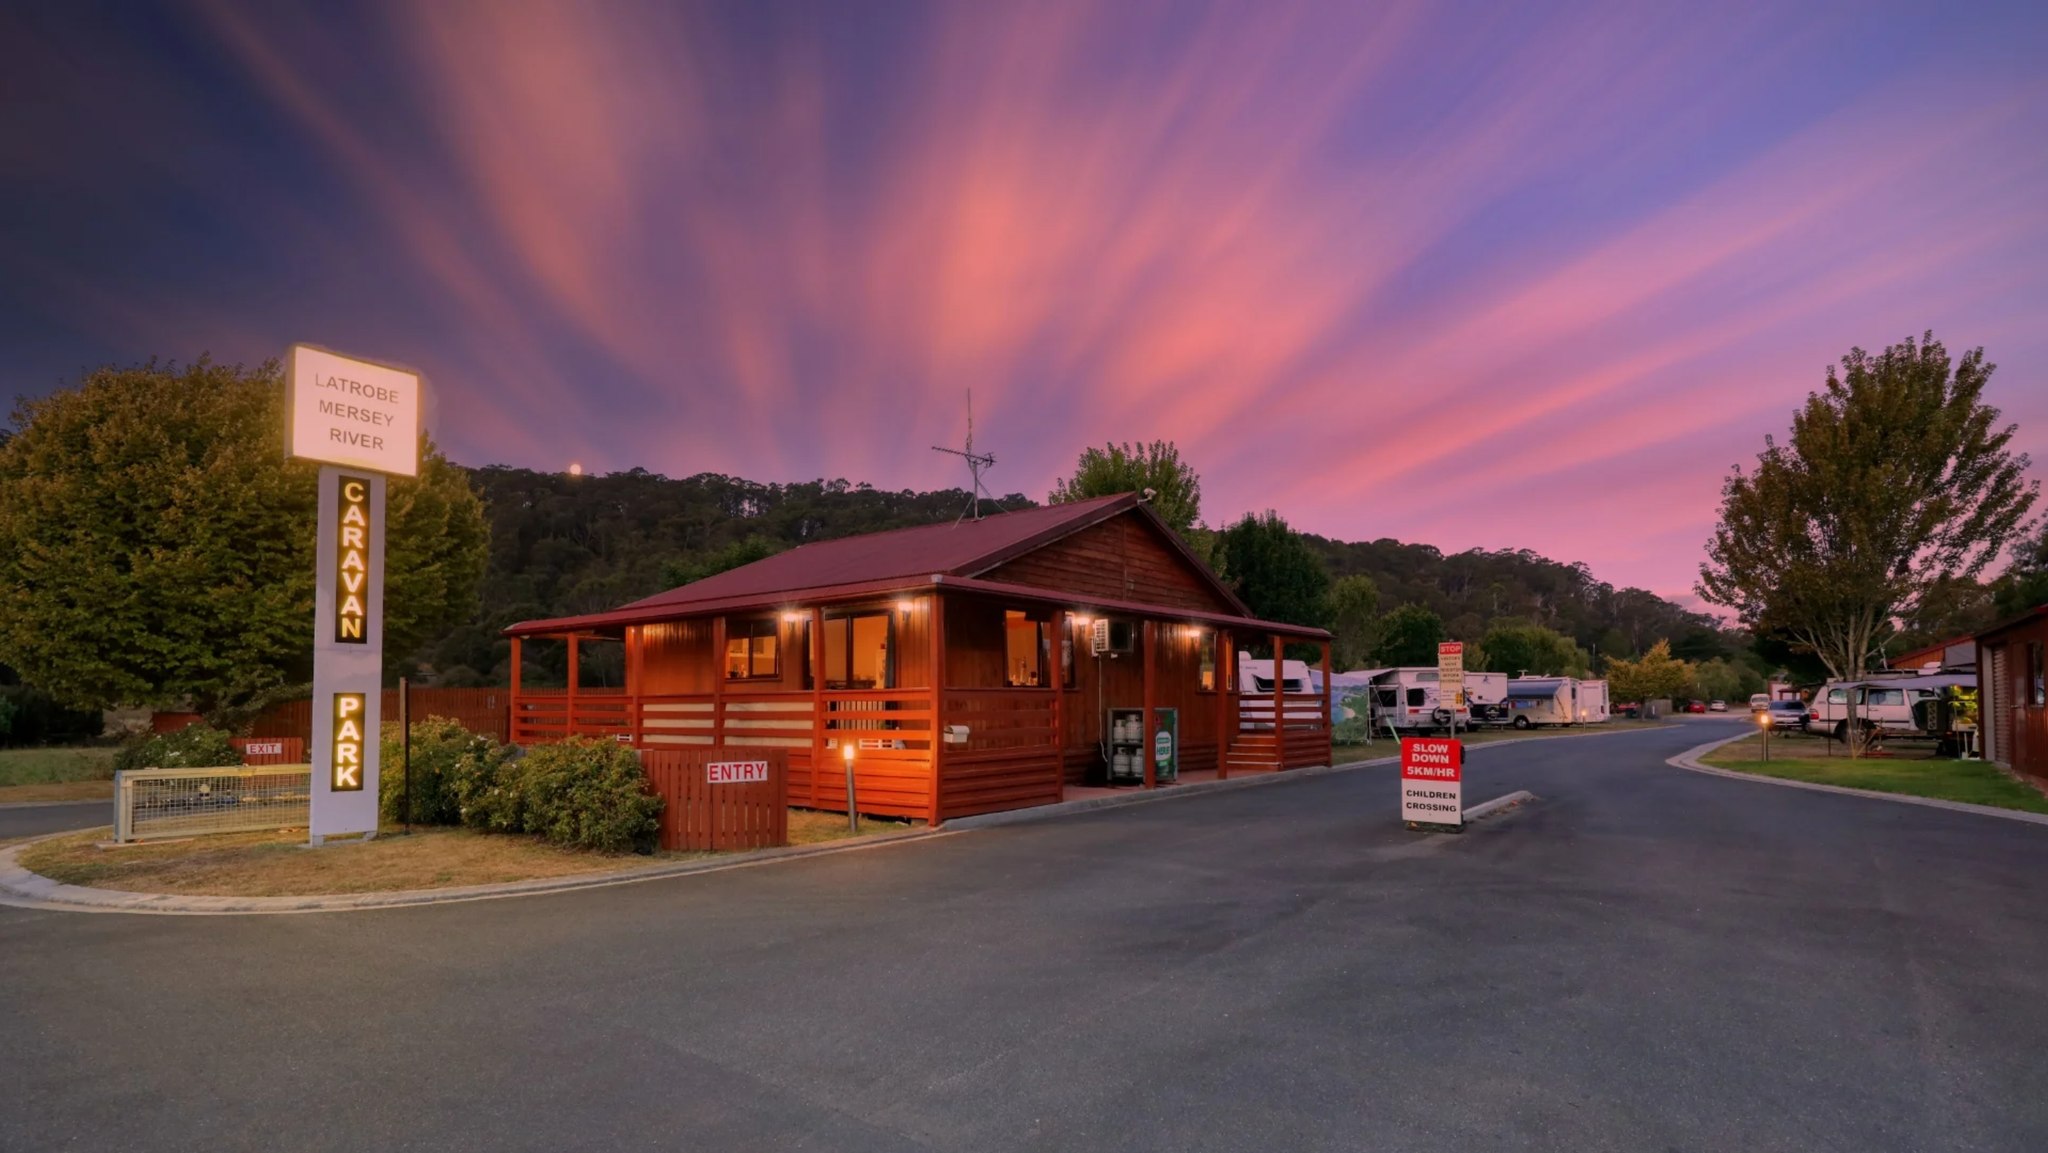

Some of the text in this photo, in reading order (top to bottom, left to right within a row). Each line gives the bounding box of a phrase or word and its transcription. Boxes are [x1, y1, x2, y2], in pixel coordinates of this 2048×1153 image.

[315, 373, 400, 404] LATROBE
[319, 399, 394, 427] MERSEY
[329, 428, 384, 450] RIVER
[340, 482, 366, 638] CARAVAN
[1440, 645, 1462, 653] STOP
[336, 697, 361, 787] PARK
[1412, 743, 1449, 754] SLOW
[250, 744, 277, 754] EXIT
[1411, 753, 1450, 764] DOWN
[709, 763, 765, 781] ENTRY
[1407, 765, 1456, 778] 5KM/HR
[1406, 789, 1457, 800] CHILDREN
[1406, 802, 1457, 813] CROSSING
